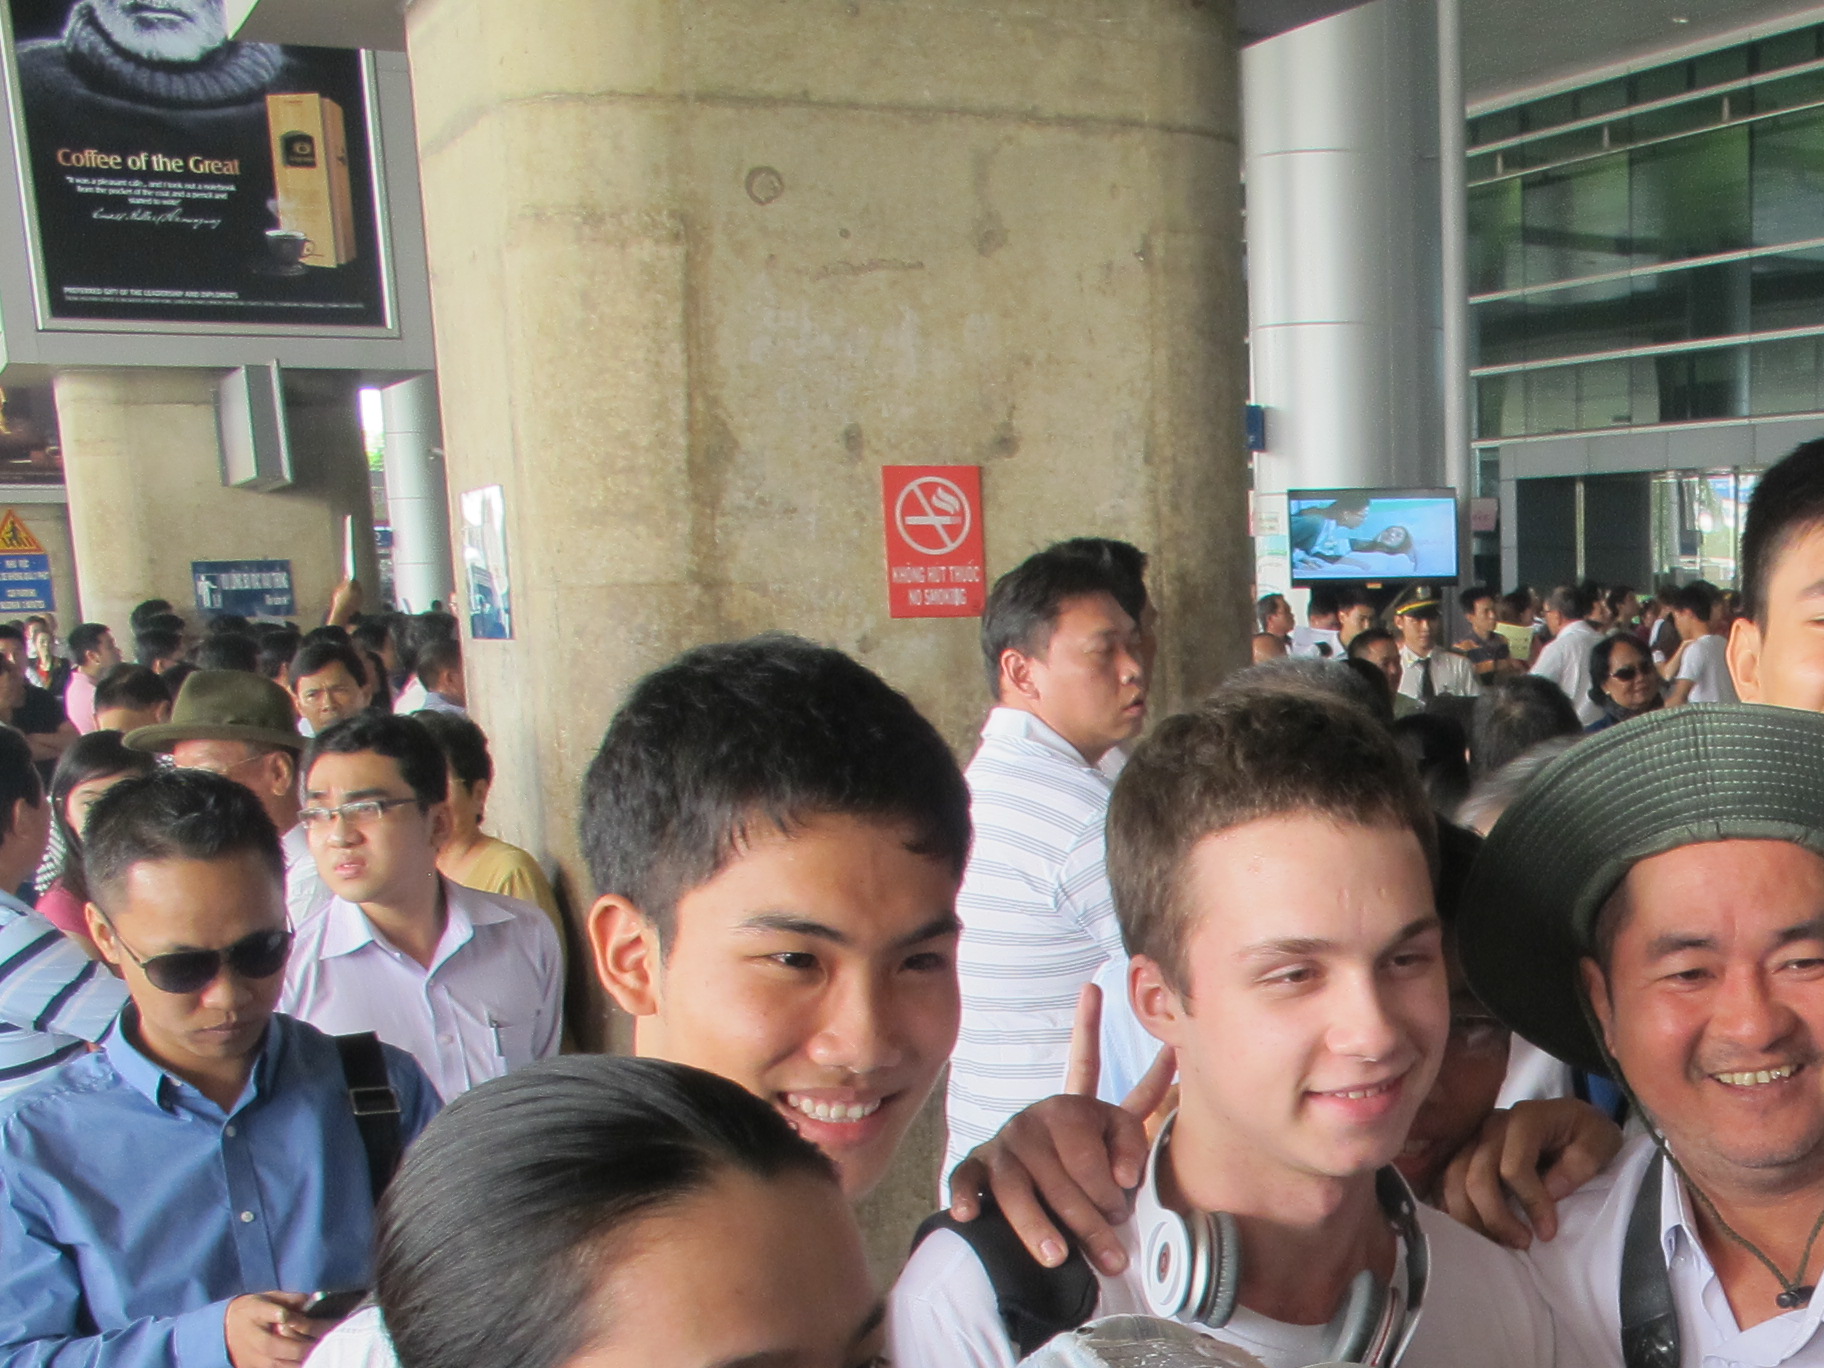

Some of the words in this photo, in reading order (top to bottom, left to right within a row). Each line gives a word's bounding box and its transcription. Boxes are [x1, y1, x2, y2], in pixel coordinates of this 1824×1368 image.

[57, 148, 122, 170] Coffee
[127, 152, 149, 172] of
[152, 154, 184, 173] the
[188, 156, 241, 175] Great
[892, 561, 925, 583] KHÔNG
[949, 559, 980, 583] THUỐC
[908, 588, 923, 606] NO
[924, 587, 967, 606] SMOKING
